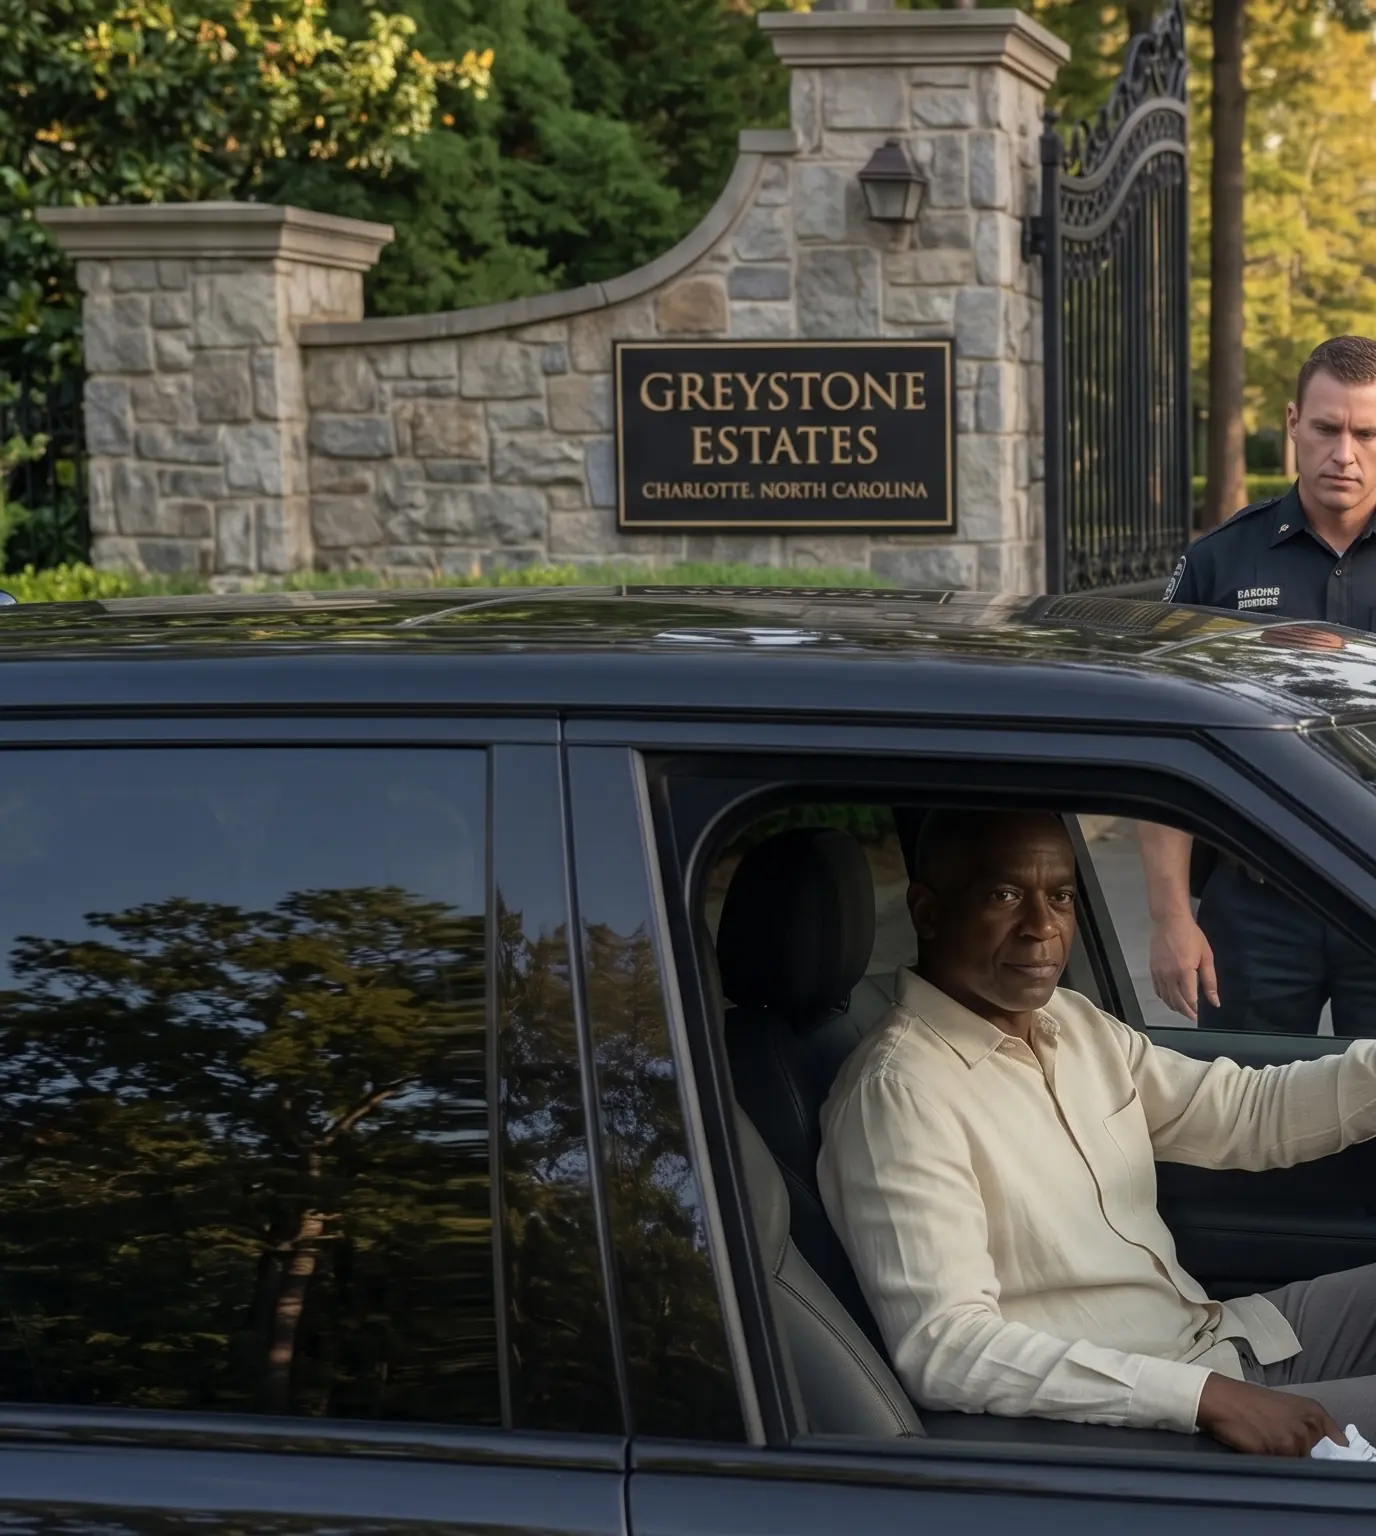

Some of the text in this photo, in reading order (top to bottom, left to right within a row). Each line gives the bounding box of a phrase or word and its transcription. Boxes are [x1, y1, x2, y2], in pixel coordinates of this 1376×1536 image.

[640, 371, 926, 411] GREYSTONE
[691, 426, 878, 465] ESTATES
[760, 482, 827, 499] NORTH
[832, 482, 928, 499] CAROLINA
